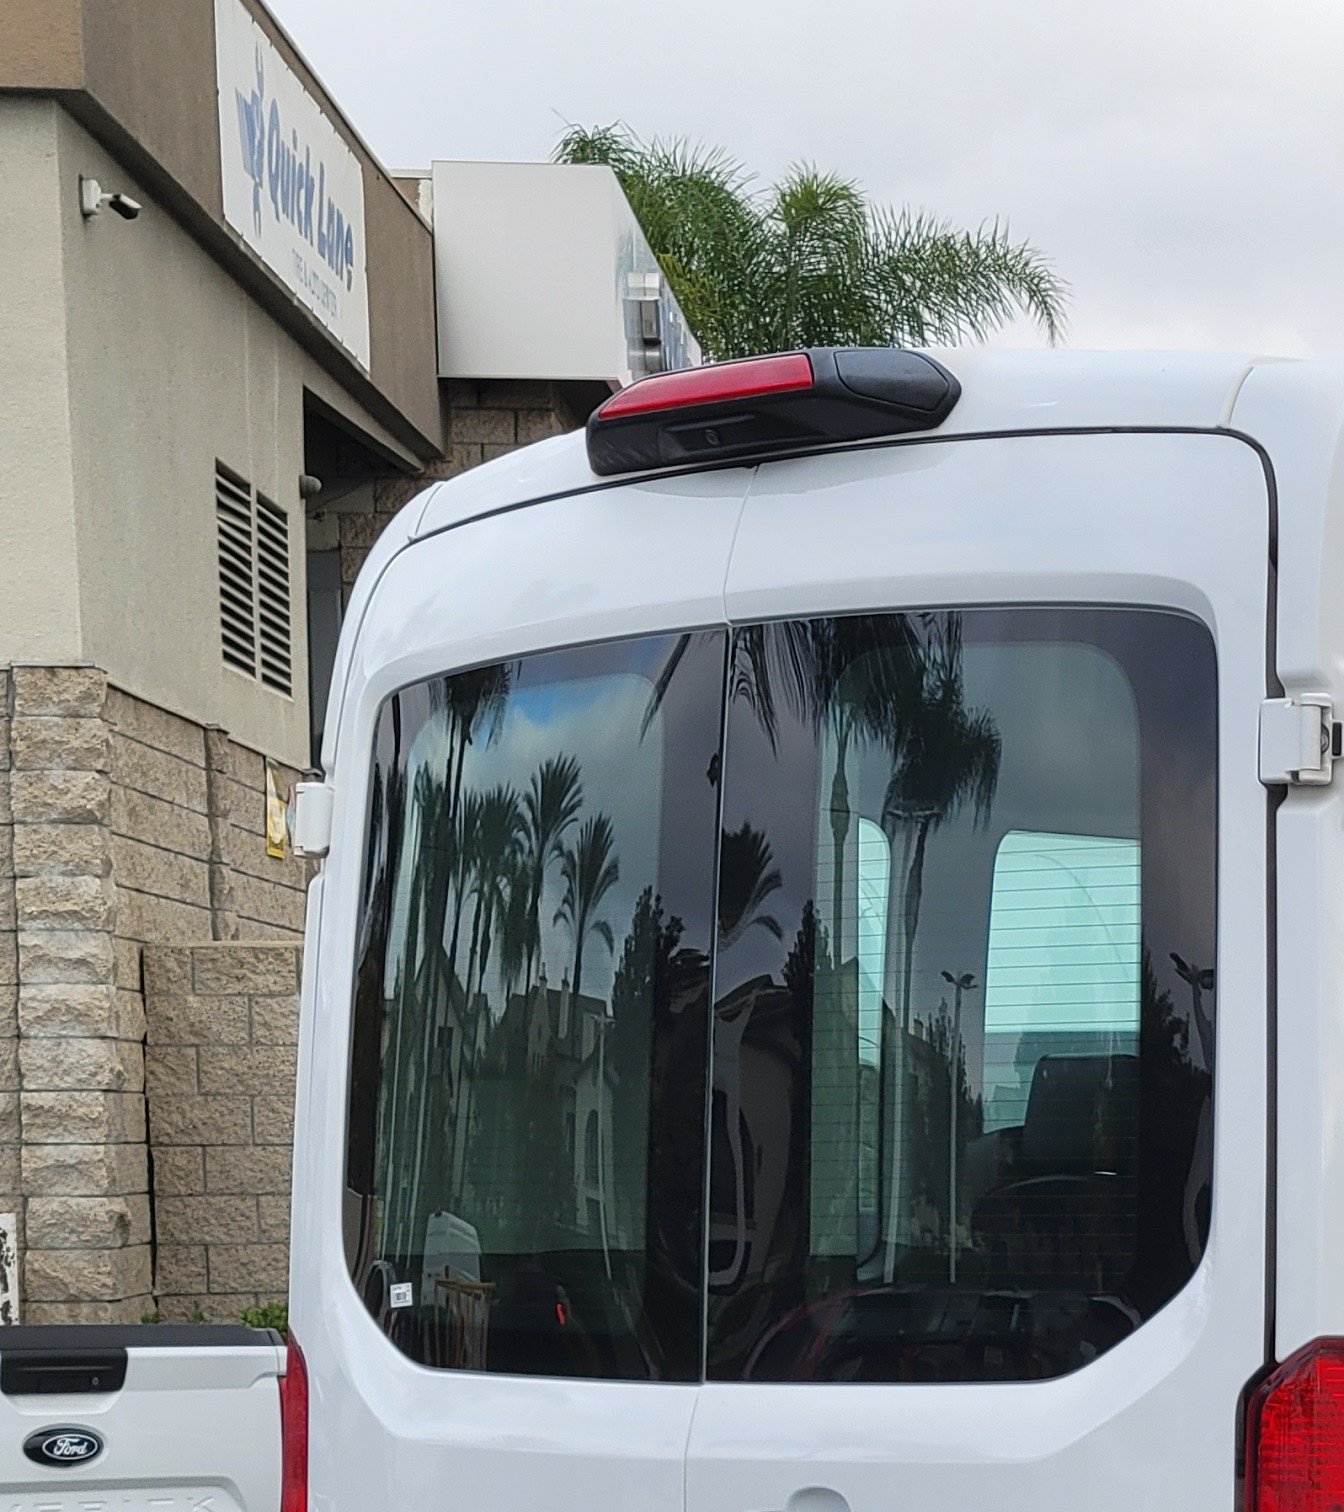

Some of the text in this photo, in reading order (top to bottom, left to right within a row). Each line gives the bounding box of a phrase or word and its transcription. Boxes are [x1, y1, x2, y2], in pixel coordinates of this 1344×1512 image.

[267, 97, 354, 292] Quick Lane
[53, 1437, 89, 1456] Ford
